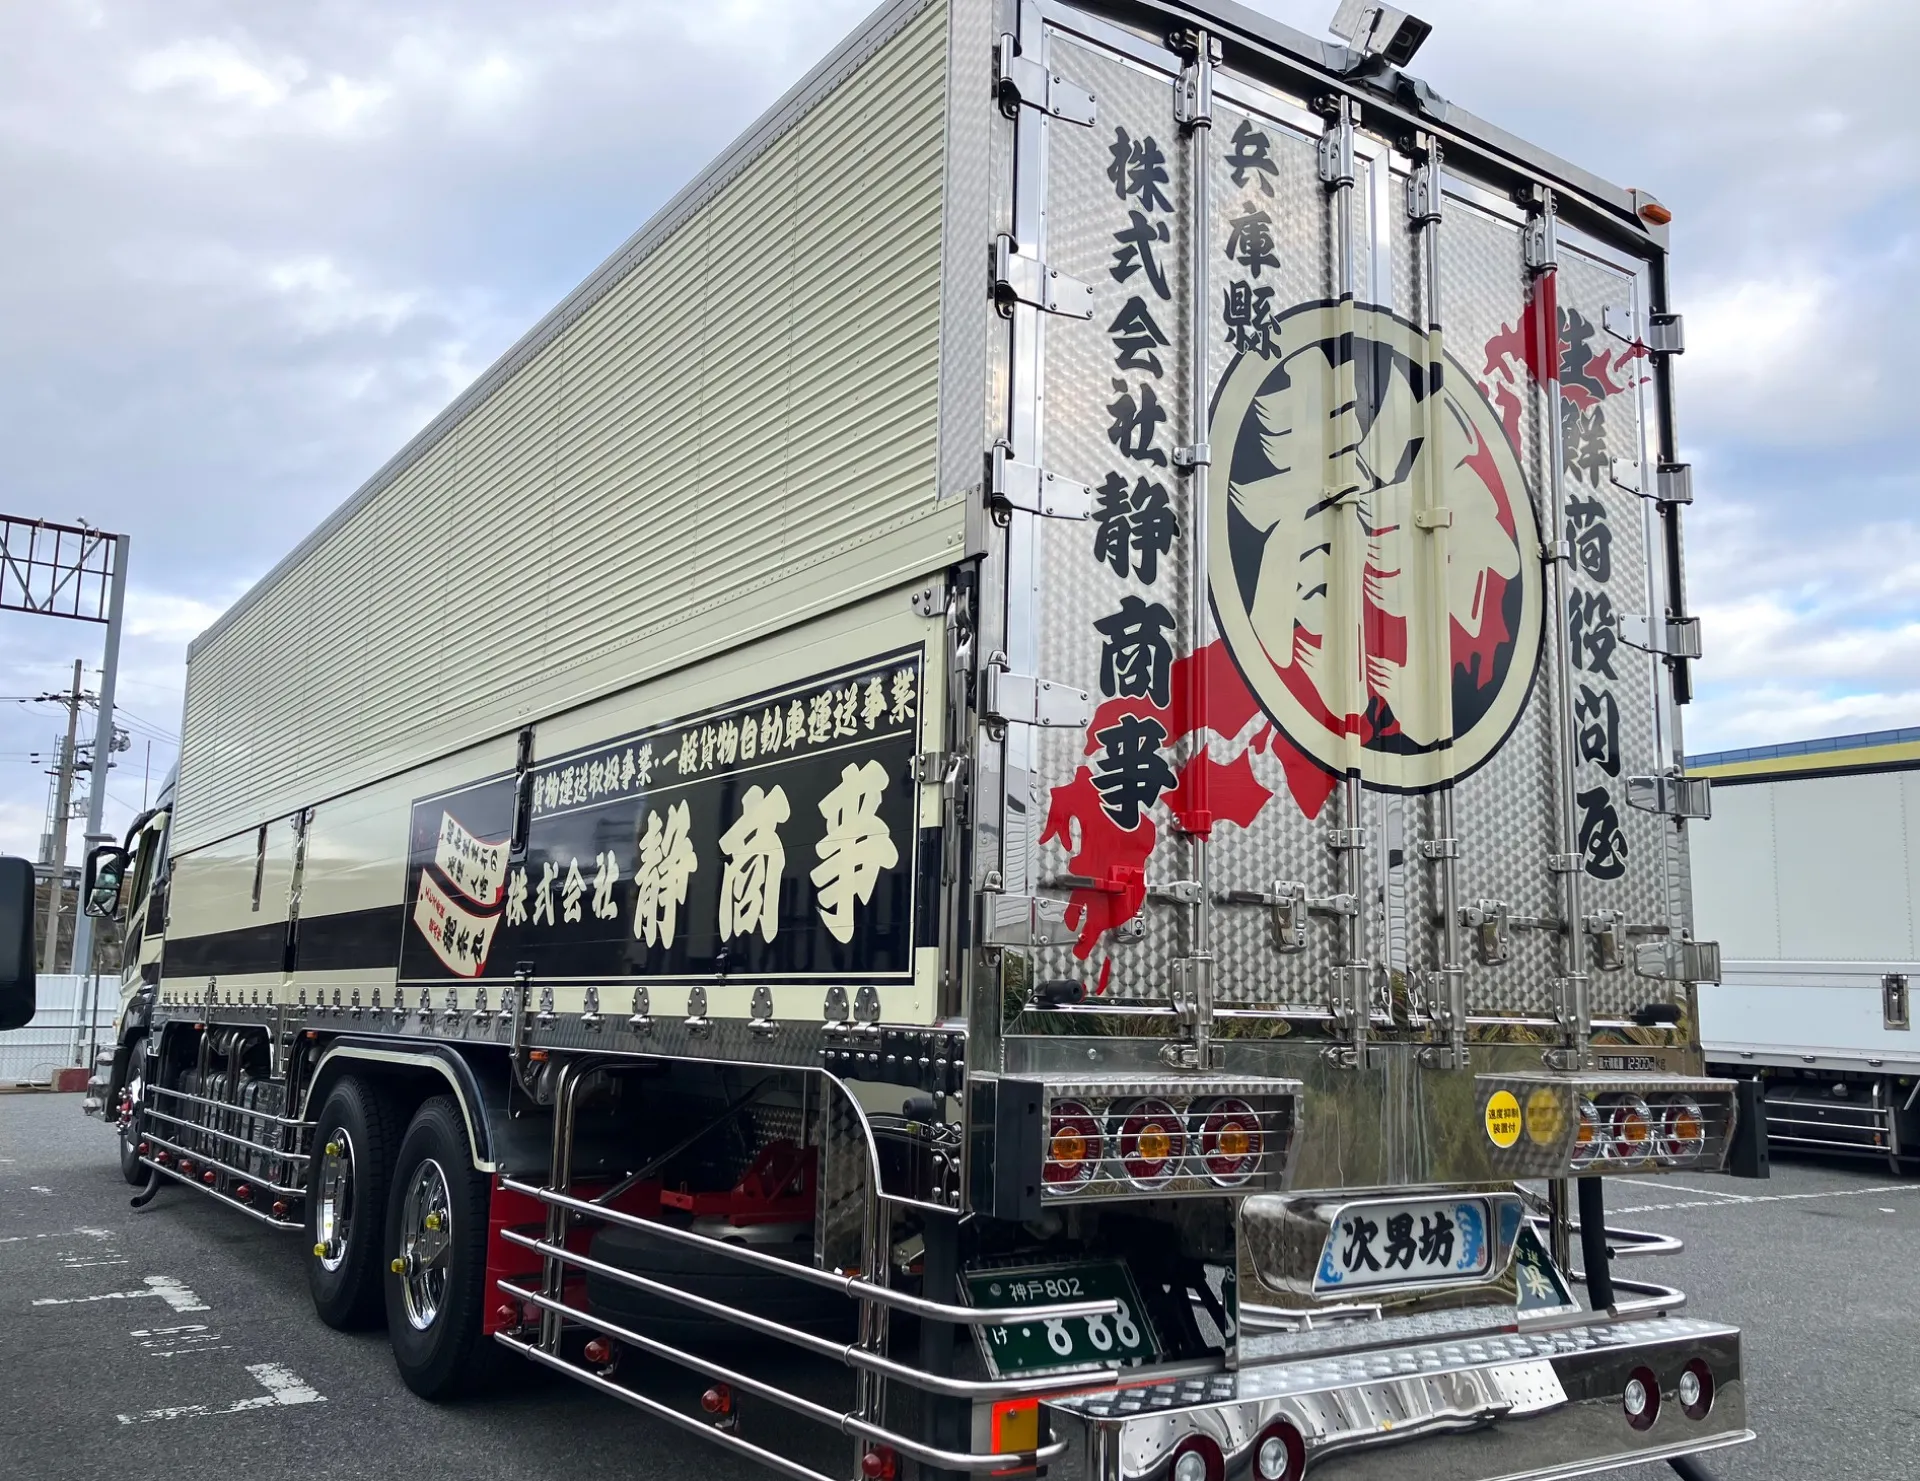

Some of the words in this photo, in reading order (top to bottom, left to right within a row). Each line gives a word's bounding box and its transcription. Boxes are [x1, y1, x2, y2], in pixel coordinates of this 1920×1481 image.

[1224, 120, 1283, 360] 兵庫縣
[1091, 126, 1180, 831] 株式会社静商事
[1488, 1108, 1519, 1120] 速度抑制
[1492, 1122, 1516, 1135] 装置付
[1342, 1211, 1455, 1273] 次男坊
[1008, 1278, 1084, 1302] 神戸802
